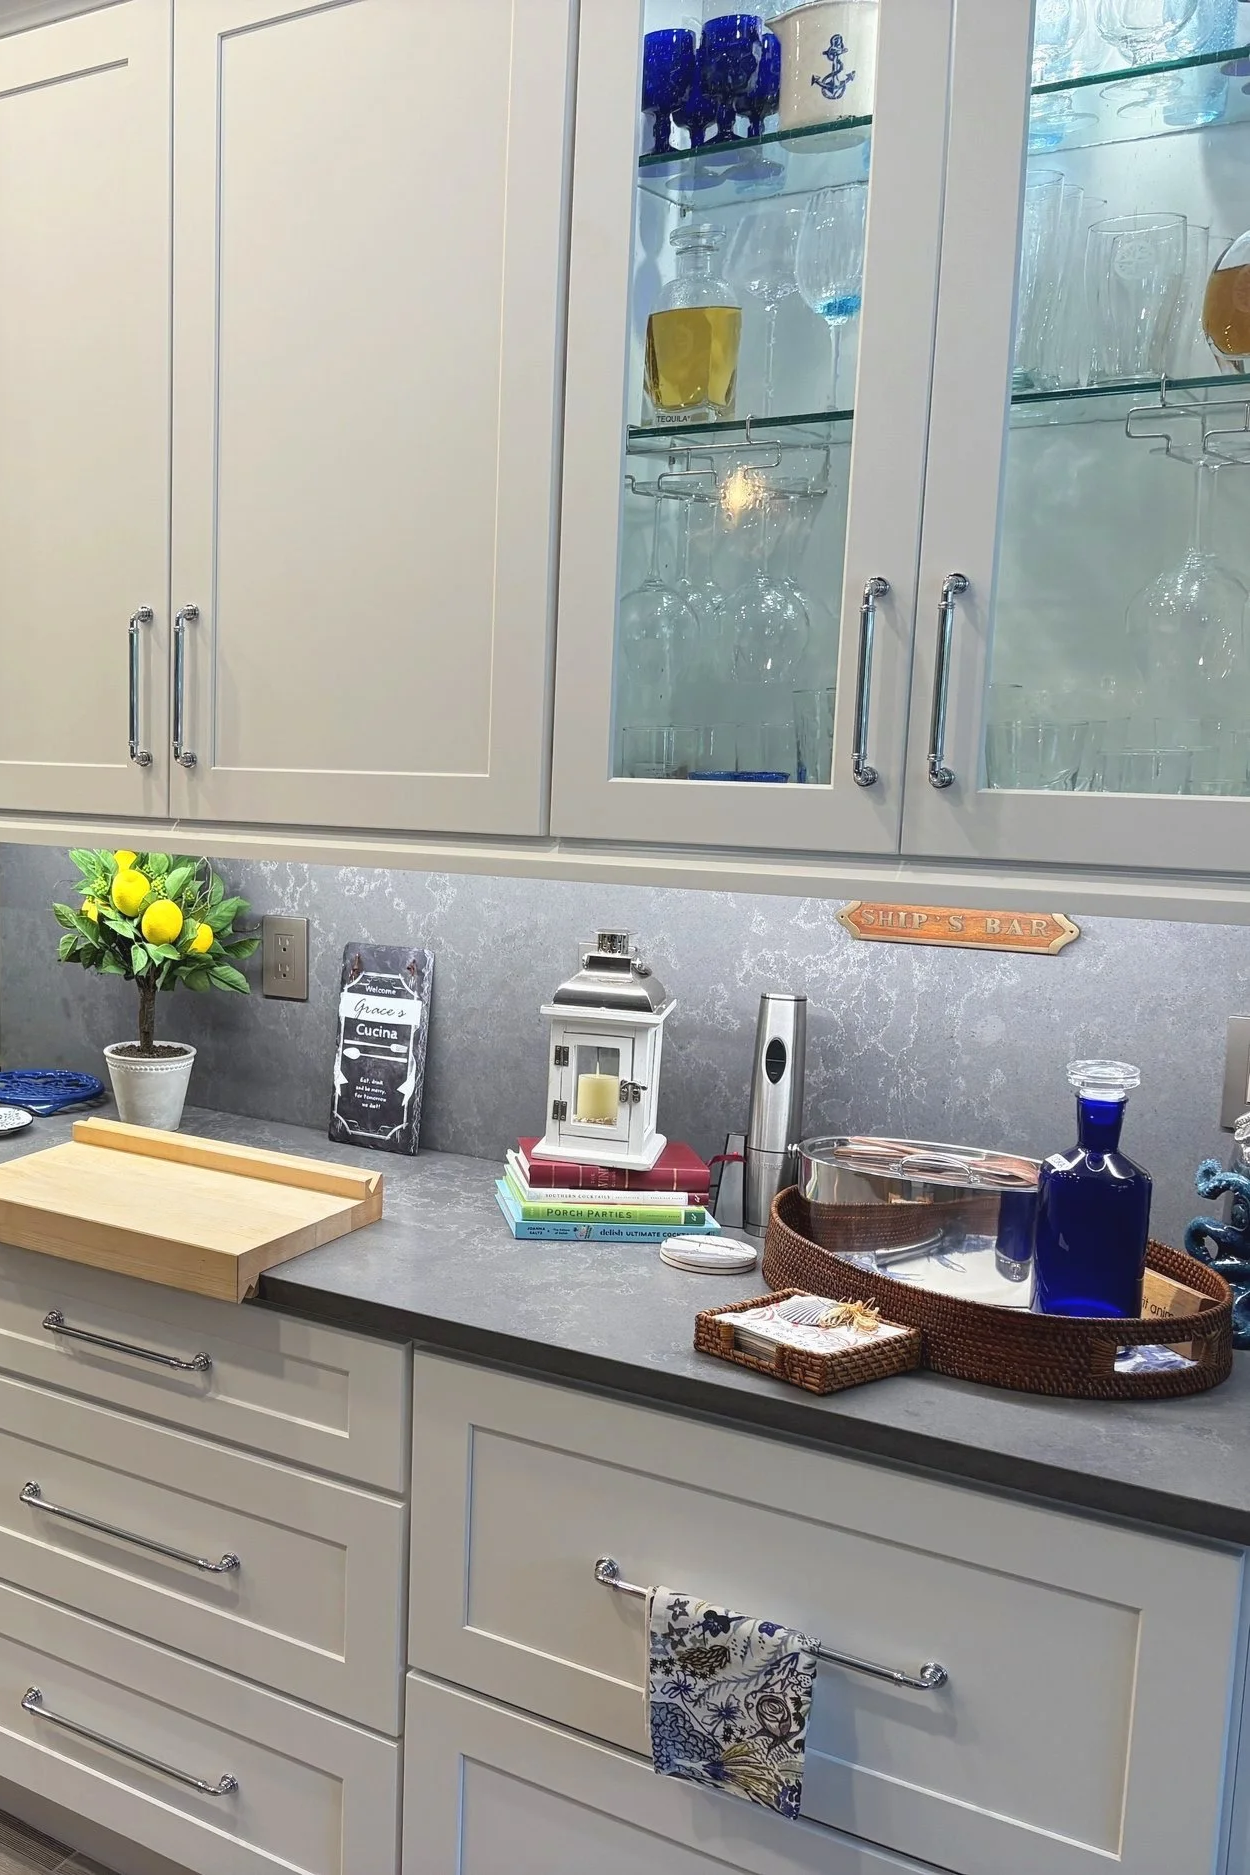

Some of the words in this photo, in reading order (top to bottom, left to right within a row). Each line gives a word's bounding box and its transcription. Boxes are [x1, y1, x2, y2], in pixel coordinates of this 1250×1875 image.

[860, 909, 966, 933] SHIP'S
[984, 917, 1050, 938] BAR
[365, 985, 397, 995] Welcome
[355, 1023, 398, 1040] Cucina
[546, 1208, 583, 1217] PORCH
[587, 1209, 632, 1219] PARTIES
[599, 1228, 624, 1237] delish
